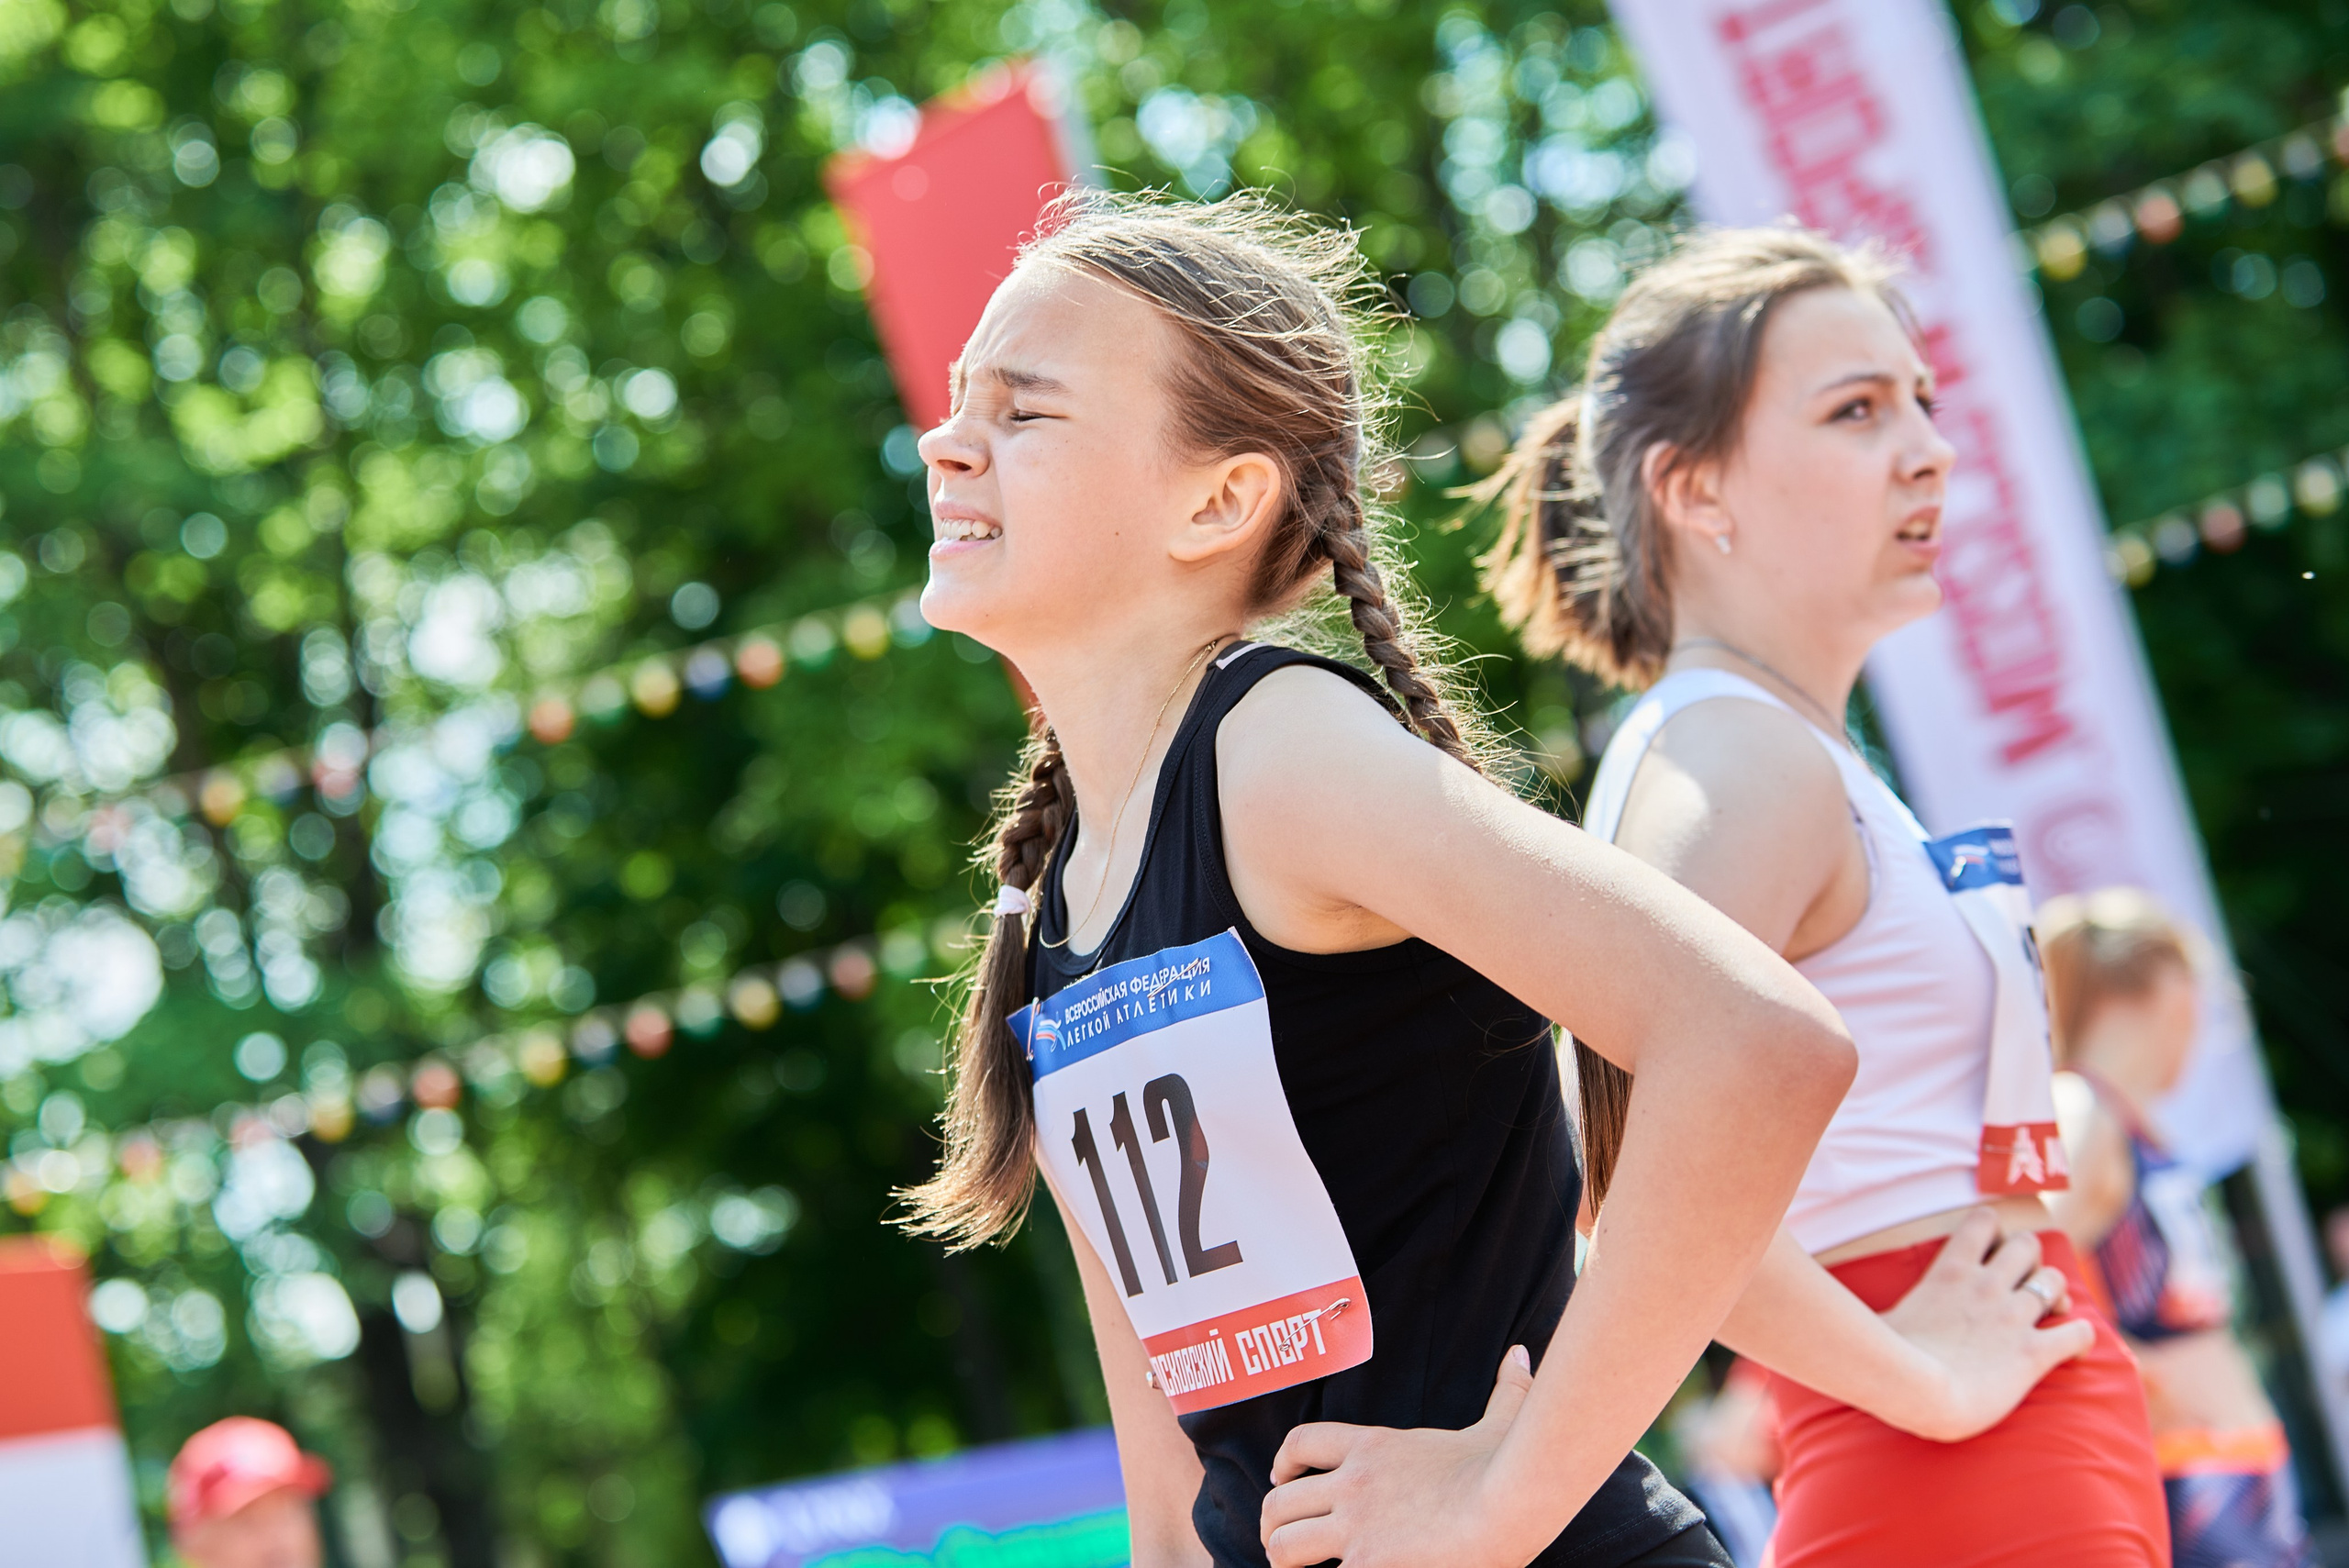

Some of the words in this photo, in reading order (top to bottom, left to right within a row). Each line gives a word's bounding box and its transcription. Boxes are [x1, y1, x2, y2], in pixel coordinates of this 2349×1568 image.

[1064, 981, 1128, 1025] ВСЕРОССИЙСКАЯ
[1130, 957, 1210, 995] ФЕДЕРАЦИЯ
[1067, 1011, 1111, 1047] ЛЕГКОЙ
[1116, 980, 1211, 1025] АТЛЕТИКИ
[1071, 1073, 1243, 1298] 112
[1149, 1329, 1235, 1397] ОСКОВСКИЙ
[1235, 1308, 1326, 1375] СПОРТ
